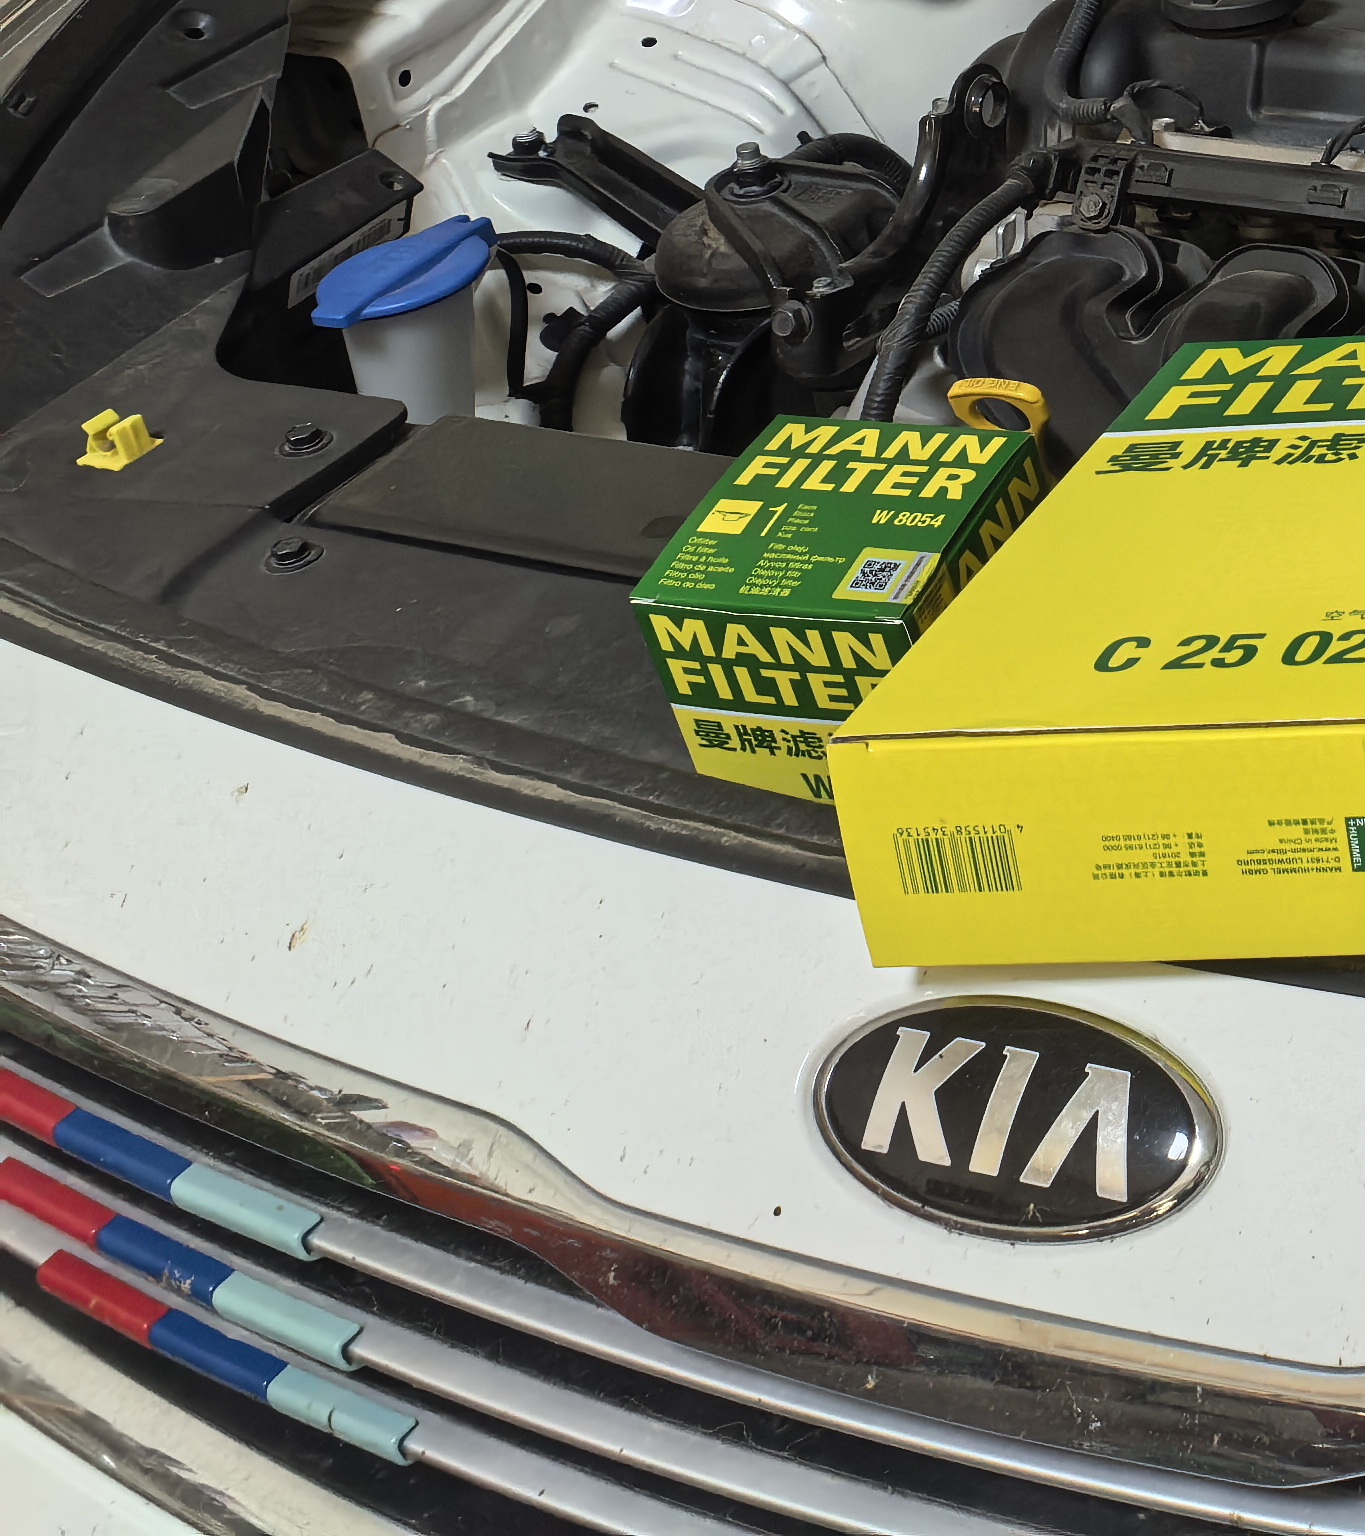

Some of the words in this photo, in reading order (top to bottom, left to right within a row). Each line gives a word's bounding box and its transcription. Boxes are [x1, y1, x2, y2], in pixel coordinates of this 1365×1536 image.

[764, 422, 1008, 465] MANN
[733, 455, 976, 500] FILTER
[760, 503, 788, 537] 1
[872, 509, 899, 526] W
[896, 510, 945, 529] 8054
[959, 457, 1043, 589] ANN
[649, 614, 892, 671] MANN
[1093, 636, 1152, 673] C
[1160, 633, 1266, 671] 25
[693, 718, 831, 761] 曼牌滤
[896, 825, 947, 838] 345136
[955, 824, 1010, 836] 011558
[861, 1026, 1131, 1203] KIA
